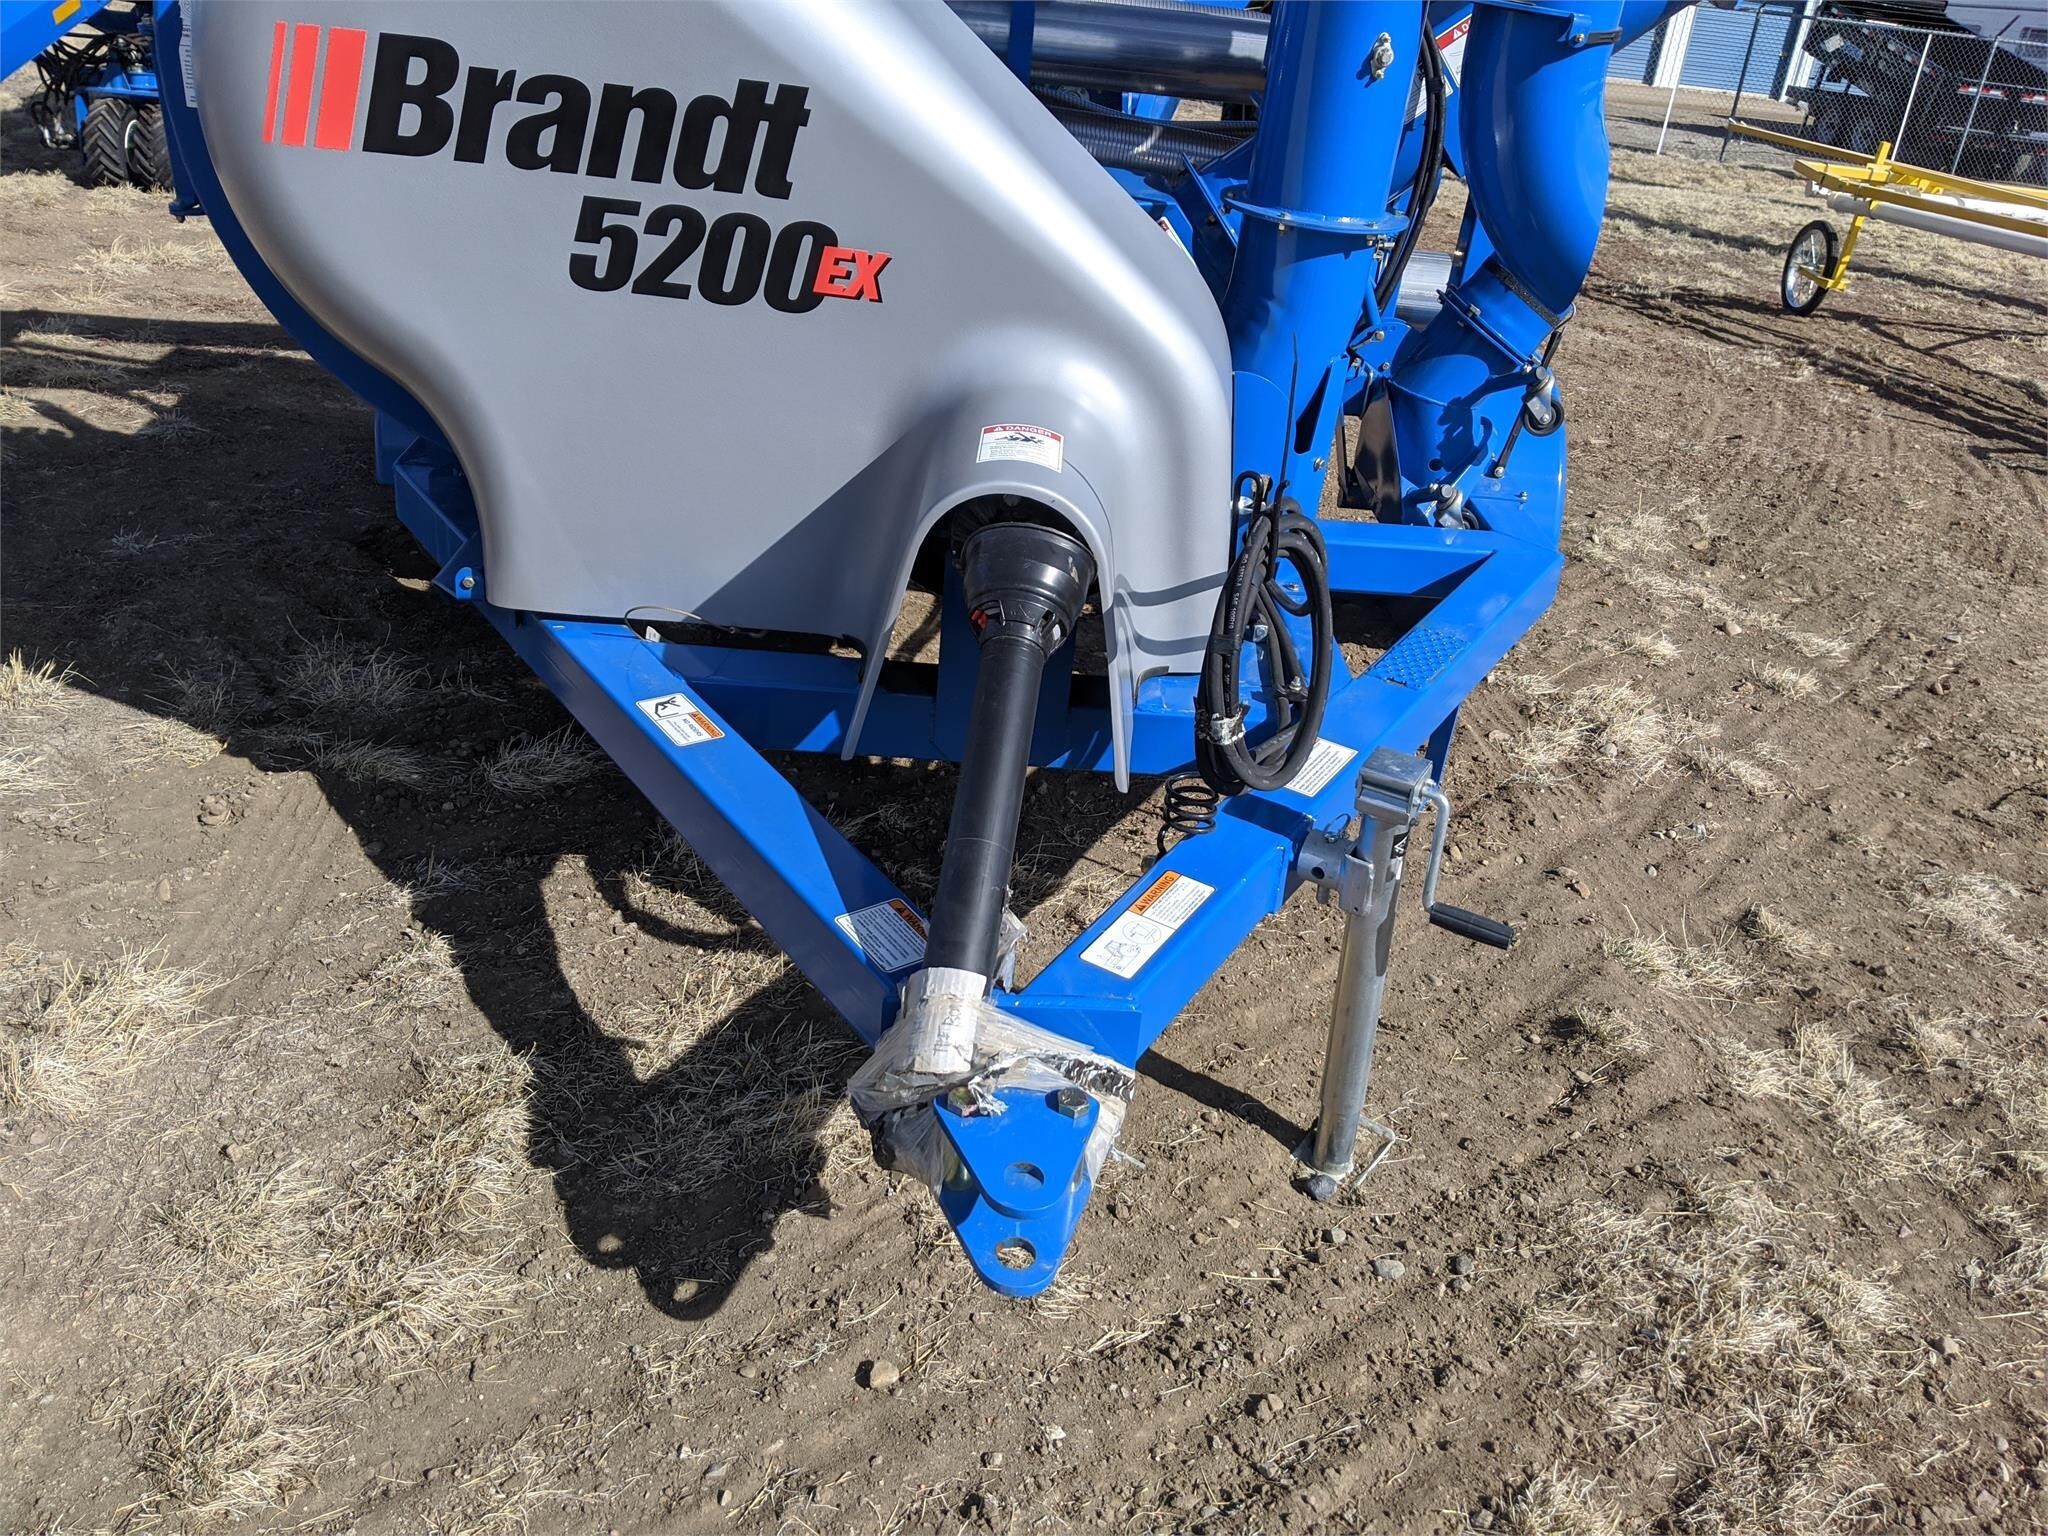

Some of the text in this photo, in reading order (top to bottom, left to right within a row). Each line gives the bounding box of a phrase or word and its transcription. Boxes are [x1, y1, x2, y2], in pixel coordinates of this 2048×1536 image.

[362, 32, 811, 200] Brandt
[1005, 426, 1052, 436] DANGER
[1141, 875, 1174, 907] WARNING
